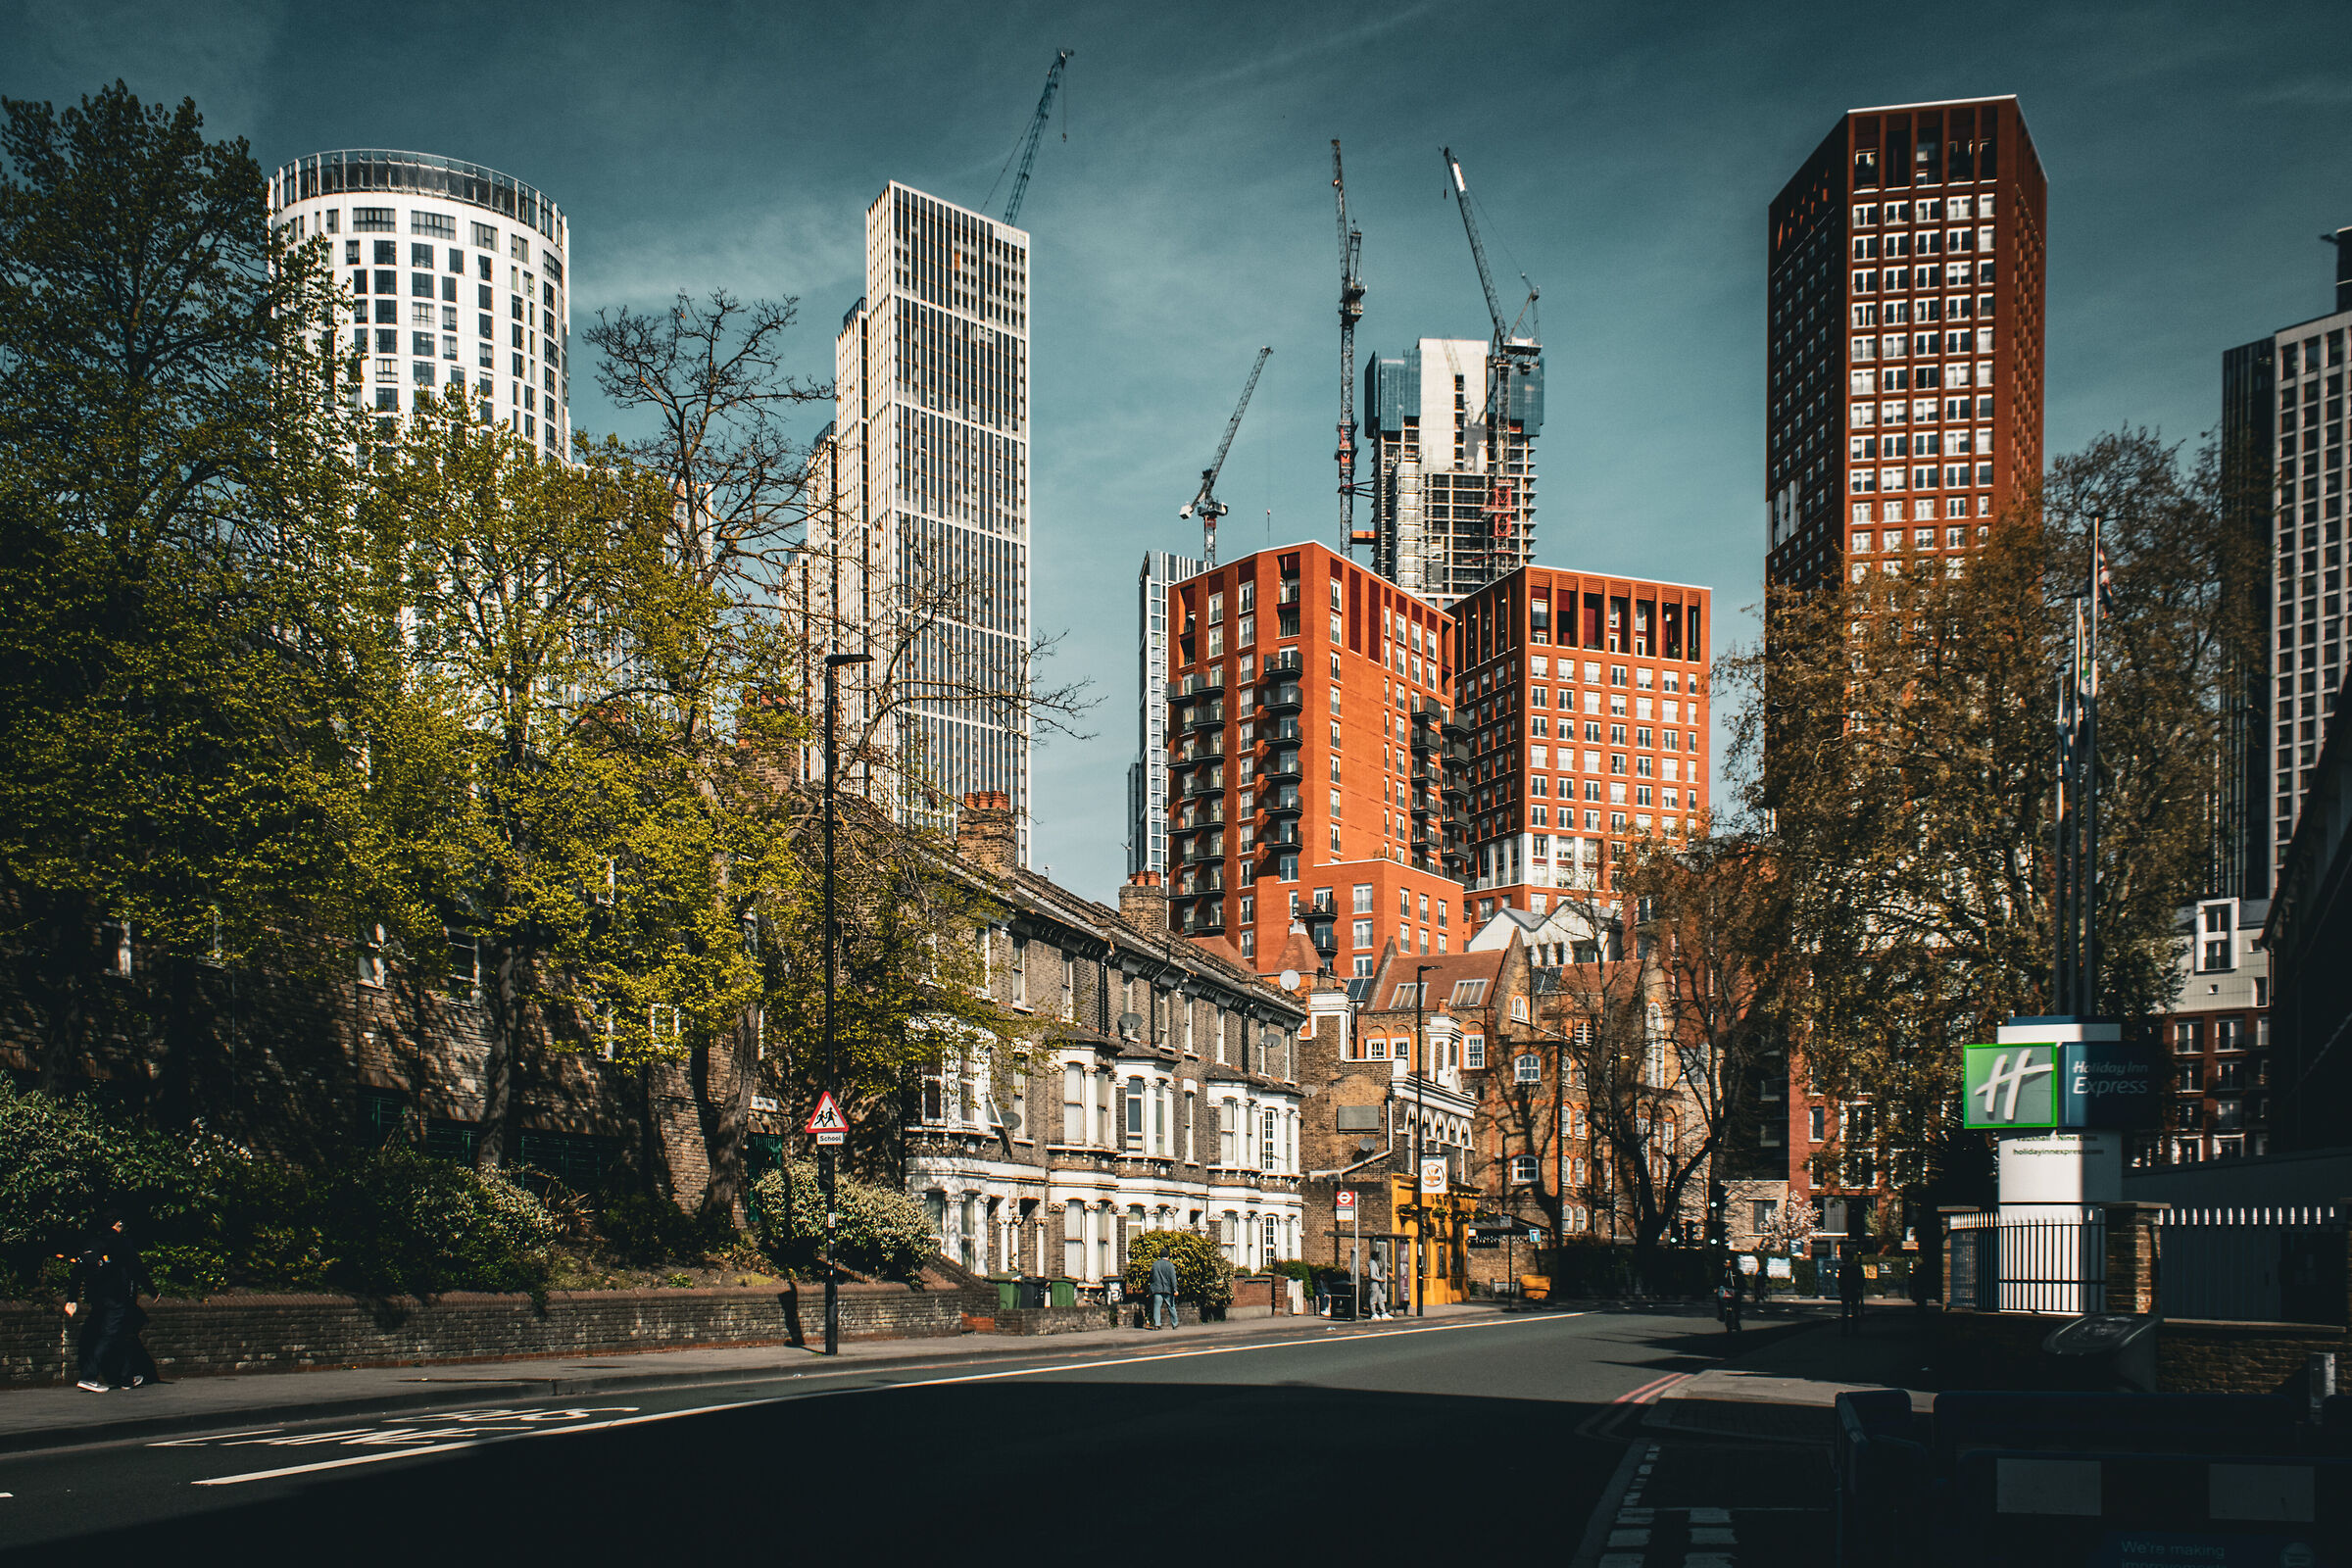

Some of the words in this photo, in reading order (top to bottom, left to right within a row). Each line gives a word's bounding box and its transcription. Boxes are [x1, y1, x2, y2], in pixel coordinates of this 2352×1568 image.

[2073, 1060, 2125, 1076] Holiday
[2127, 1060, 2148, 1074] Inn
[2073, 1076, 2148, 1099] Express
[381, 1406, 640, 1423] BUS
[2122, 1540, 2166, 1554] We're
[2170, 1544, 2226, 1560] making
